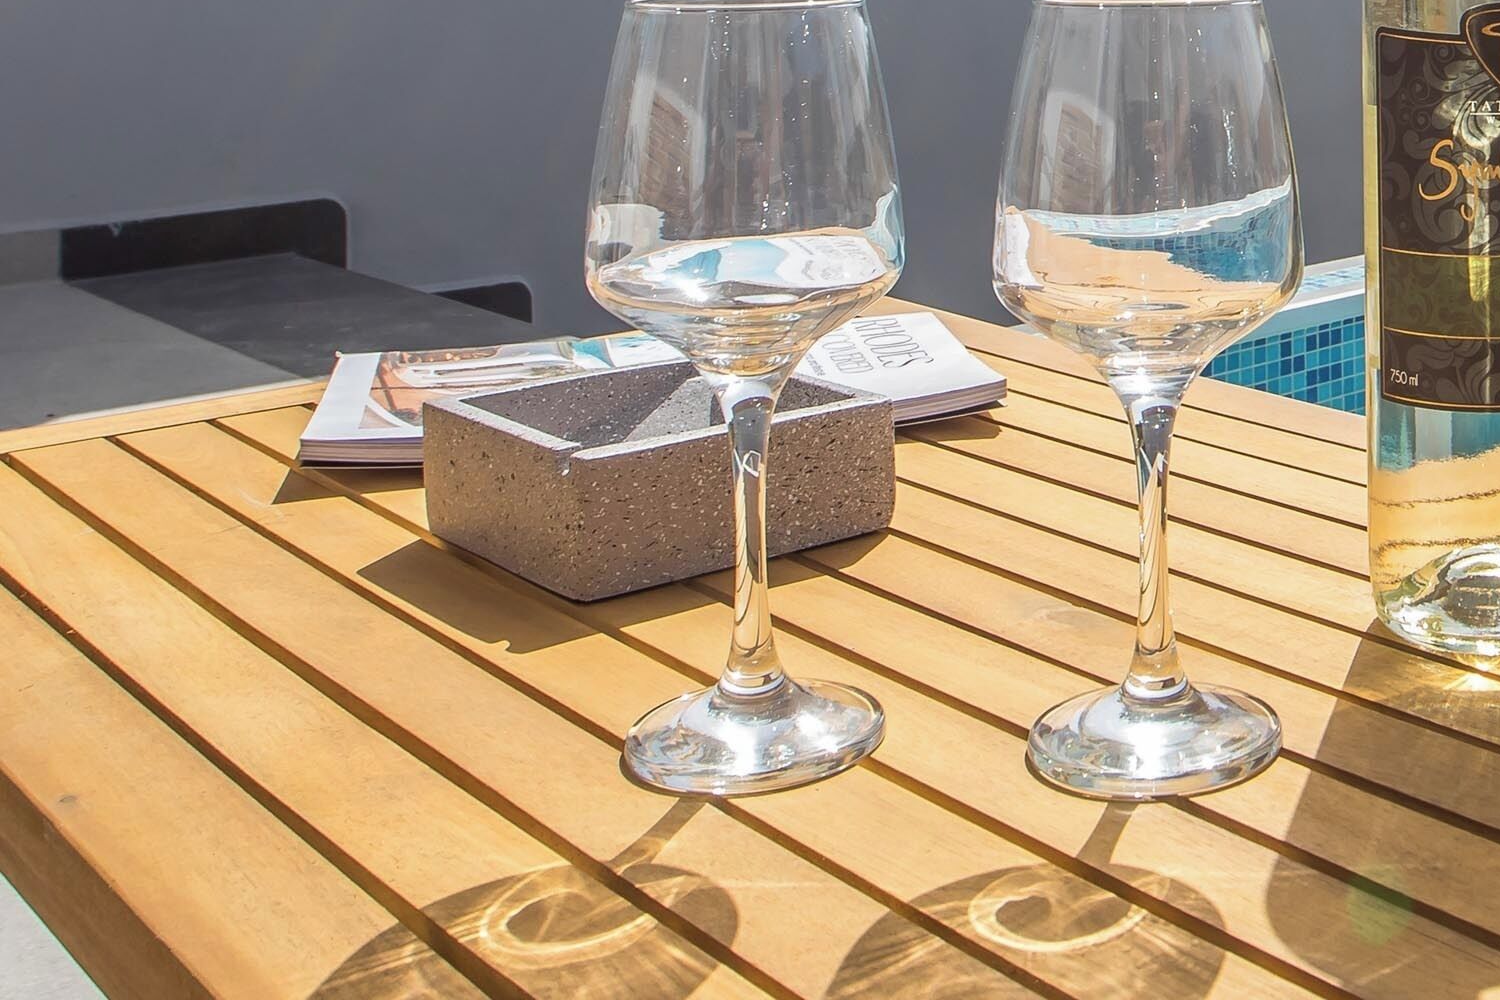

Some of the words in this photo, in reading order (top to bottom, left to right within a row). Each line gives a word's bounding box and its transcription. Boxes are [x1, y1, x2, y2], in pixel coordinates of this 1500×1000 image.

[851, 318, 934, 368] RHODES
[1390, 369, 1408, 385] 750
[1409, 373, 1419, 387] ml
